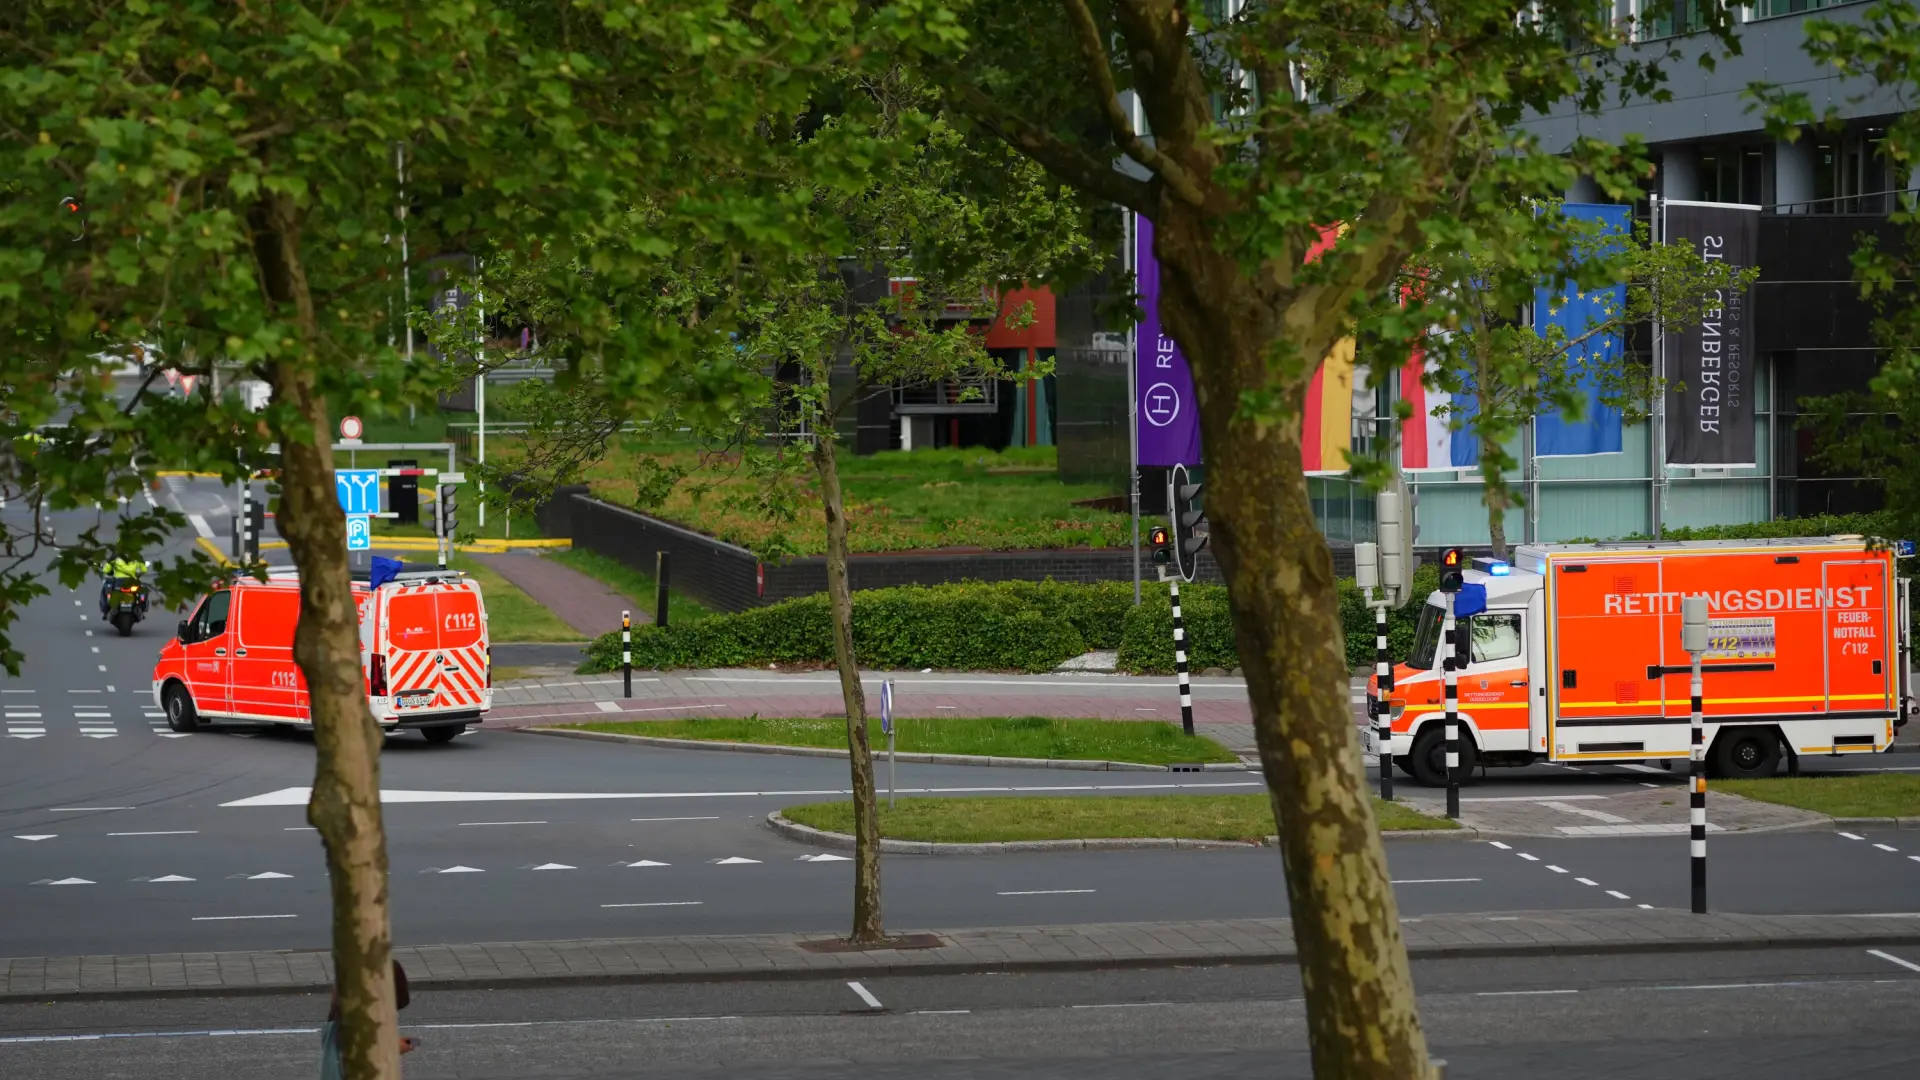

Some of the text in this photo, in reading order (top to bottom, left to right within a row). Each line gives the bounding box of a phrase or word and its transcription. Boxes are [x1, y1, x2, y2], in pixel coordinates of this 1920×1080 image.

[1156, 333, 1174, 368] RE
[1604, 586, 1872, 614] RETTNGSDIENST
[453, 613, 475, 628] 112
[1838, 611, 1873, 624] FEUER-
[1834, 627, 1877, 639] NOTFALL
[1710, 637, 1738, 650] 112
[1852, 642, 1868, 655] 112
[278, 672, 297, 687] 112
